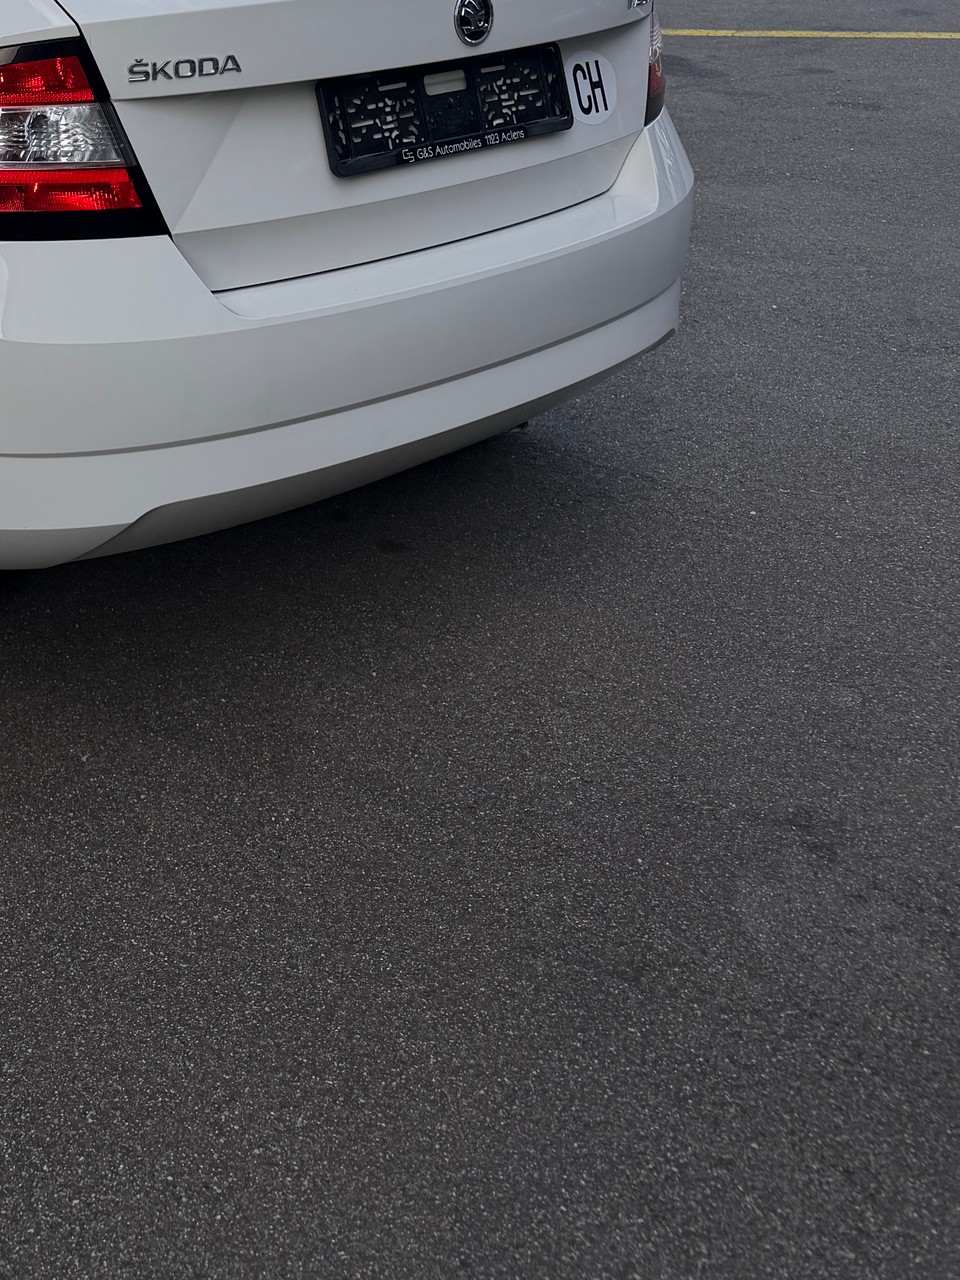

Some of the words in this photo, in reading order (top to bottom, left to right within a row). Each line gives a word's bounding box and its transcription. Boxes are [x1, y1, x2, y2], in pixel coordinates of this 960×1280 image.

[127, 54, 243, 83] ŠKODA
[572, 59, 609, 116] CH
[416, 146, 434, 160] G&S
[435, 138, 482, 156] Automobiles
[501, 129, 525, 142] Aclens
